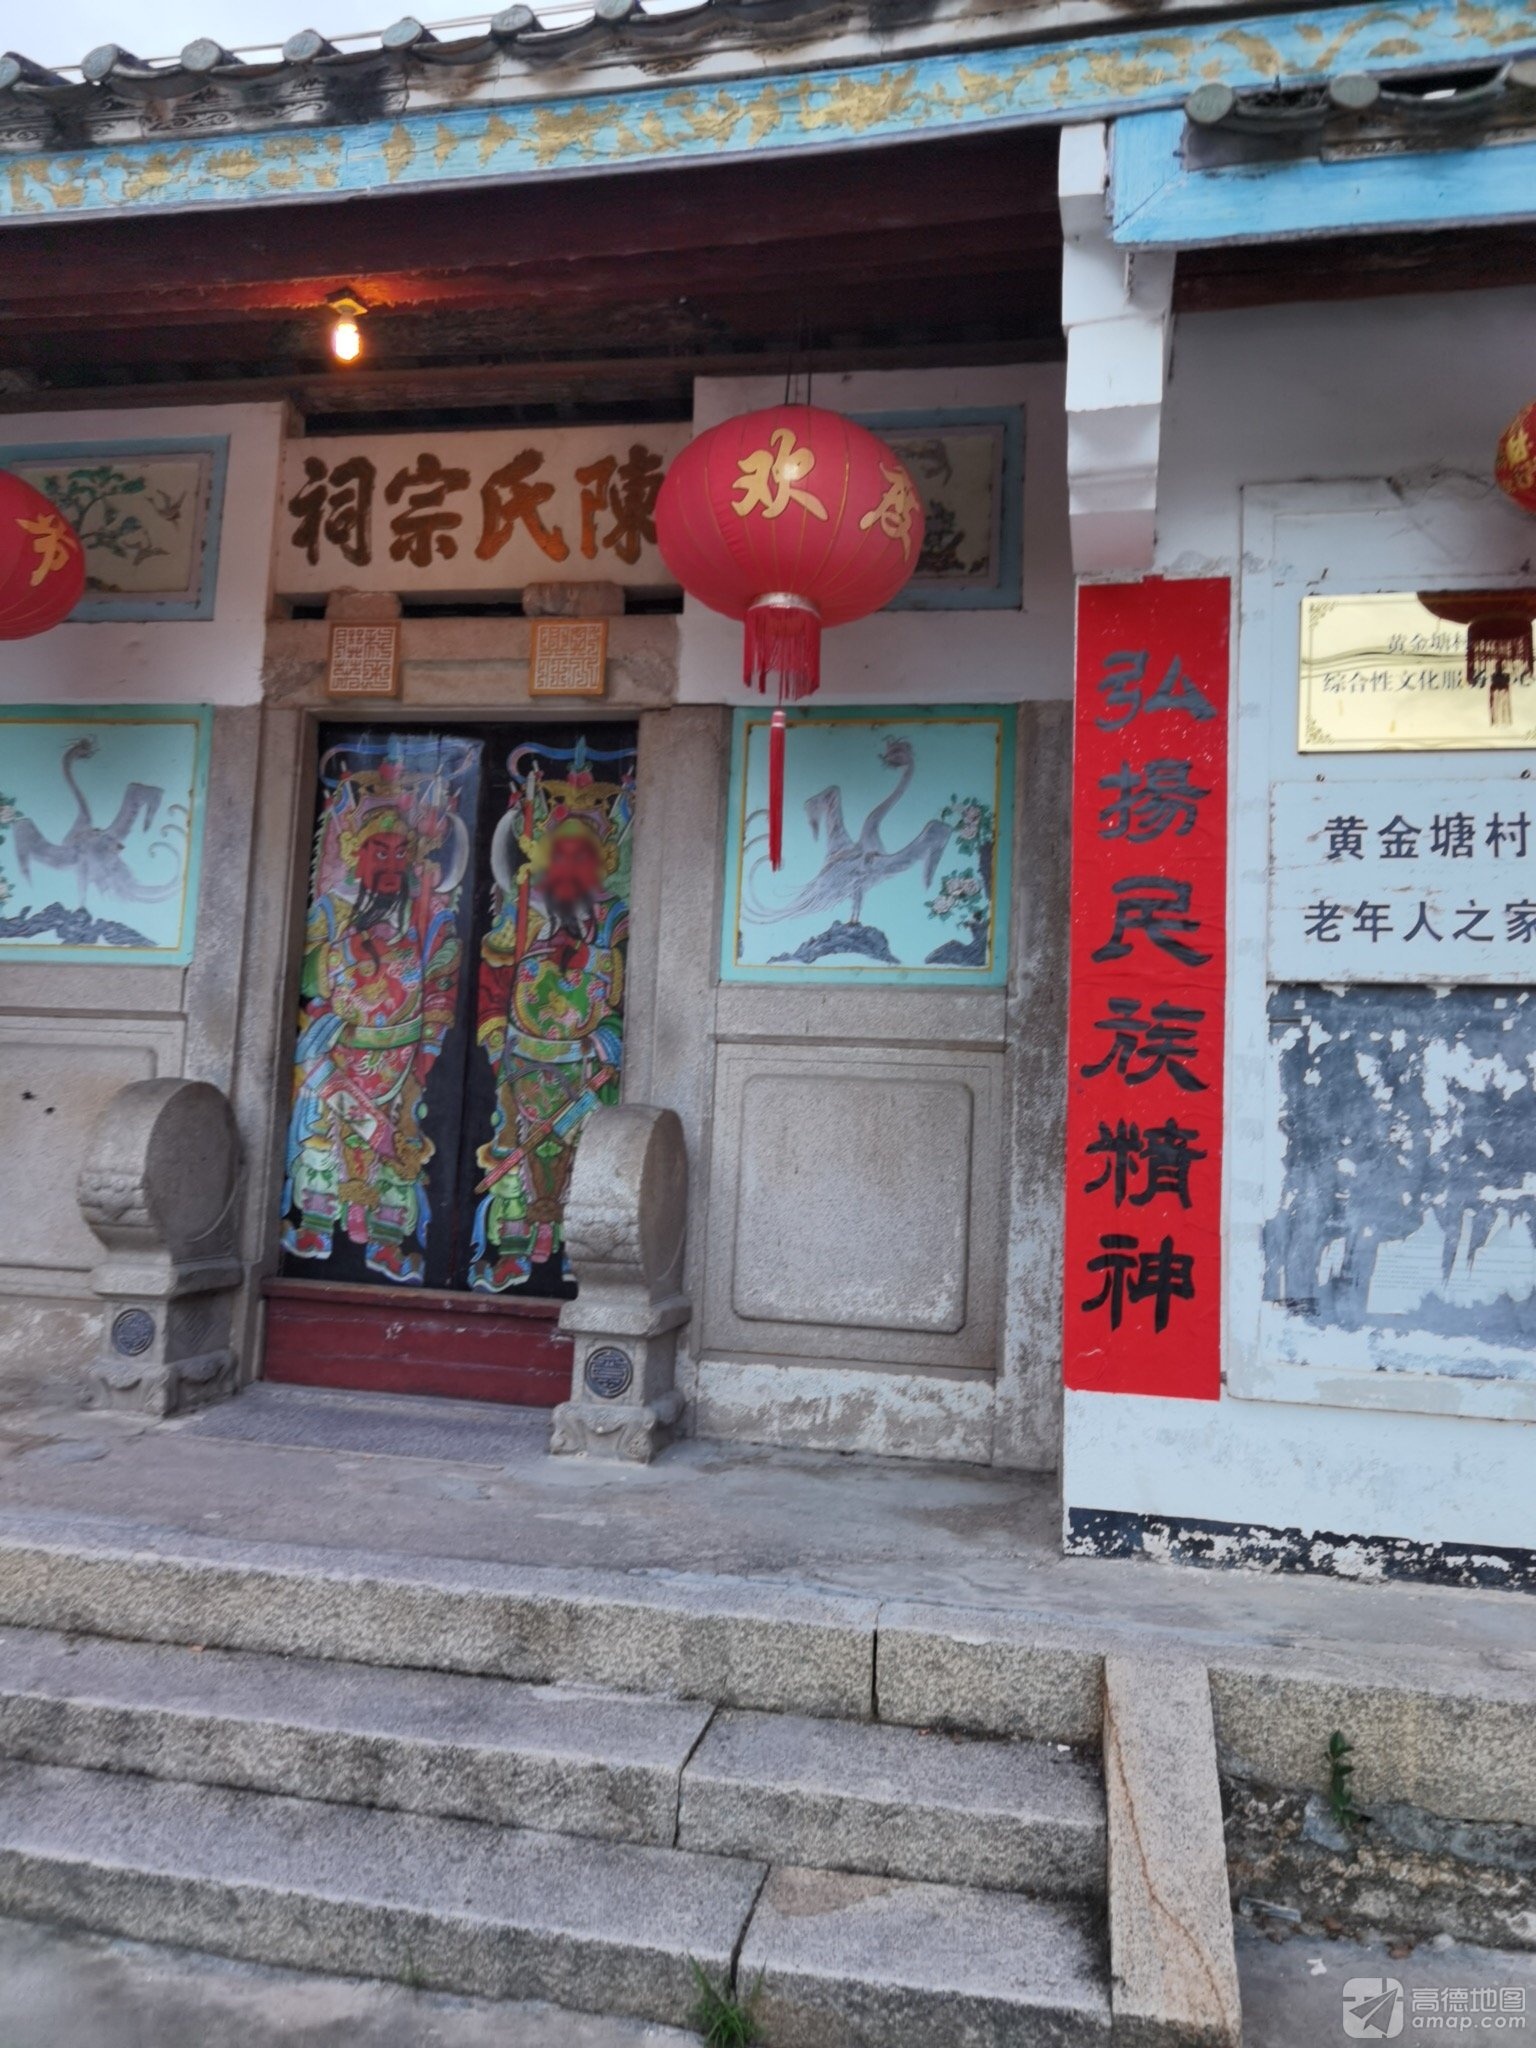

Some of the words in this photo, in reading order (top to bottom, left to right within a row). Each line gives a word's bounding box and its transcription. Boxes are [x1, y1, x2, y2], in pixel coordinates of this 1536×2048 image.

[288, 443, 666, 568] 陳氏宗祠
[1321, 668, 1534, 695] 综合性文化服务心
[1324, 811, 1531, 861] 黄金塘村
[1303, 898, 1536, 944] 老年人之家
